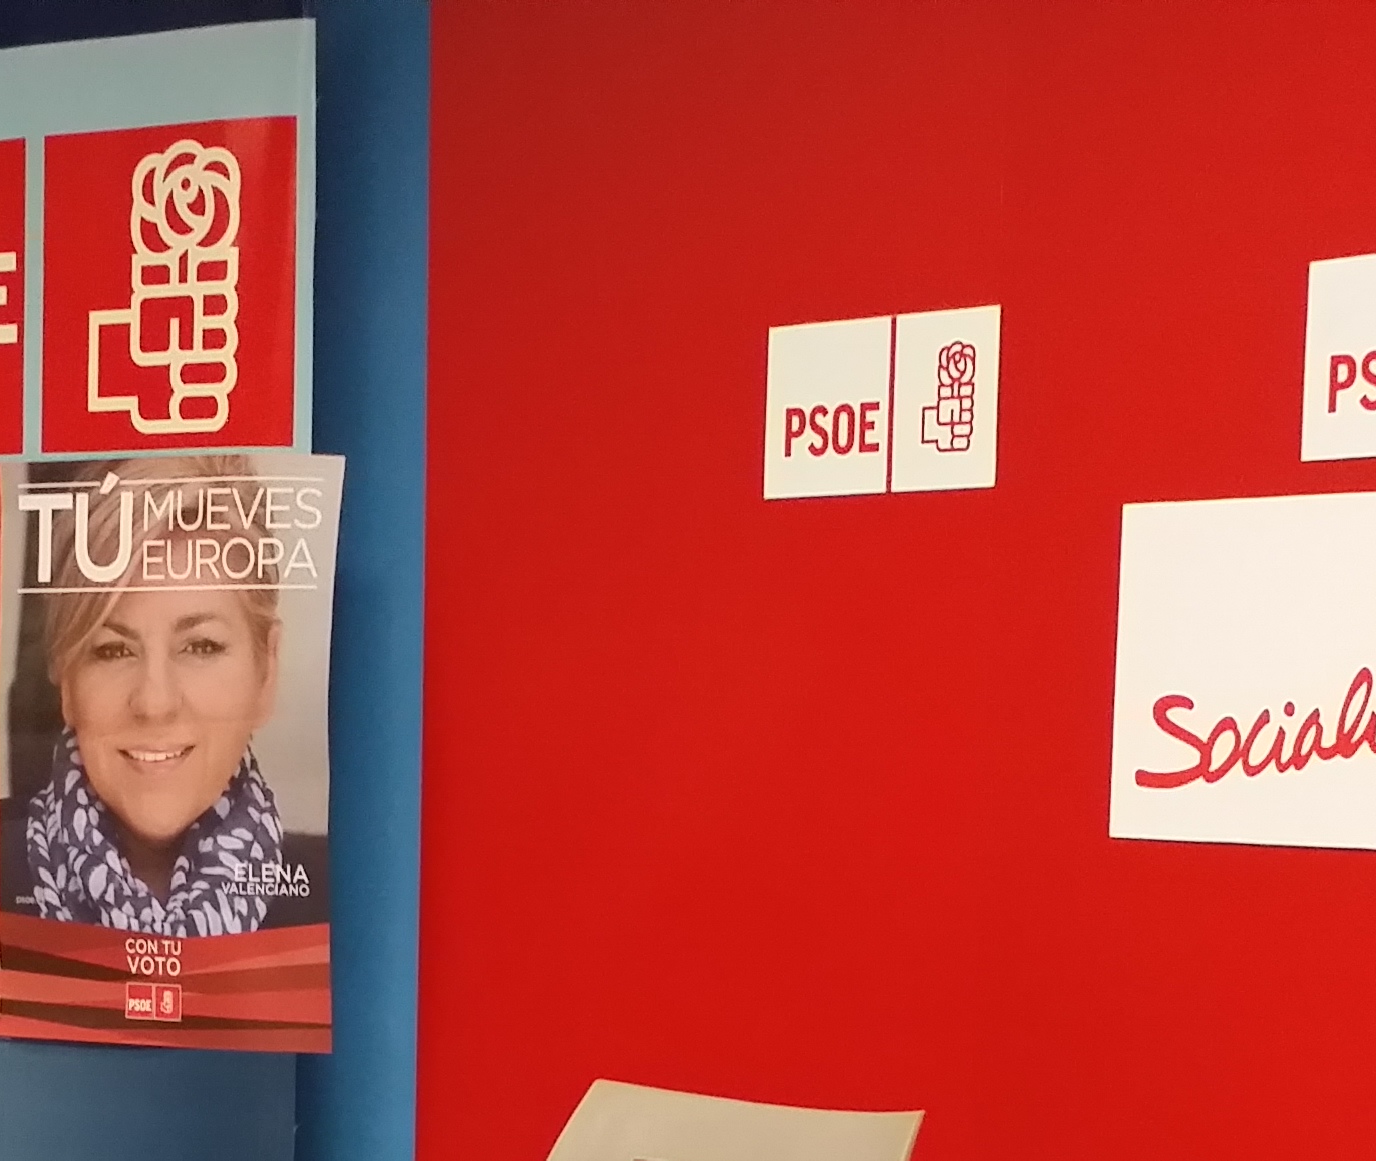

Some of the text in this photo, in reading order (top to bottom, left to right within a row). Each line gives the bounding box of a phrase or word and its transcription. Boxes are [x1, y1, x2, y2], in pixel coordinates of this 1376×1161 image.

[784, 401, 881, 458] PSOE
[19, 471, 322, 584] TÚ MUEVES
[142, 537, 318, 582] EUROPA
[233, 863, 311, 884] ELENA
[220, 881, 311, 898] VALENCIANO
[125, 938, 182, 956] CON TU
[127, 956, 181, 977] VOTO
[128, 998, 153, 1013] PSOE
